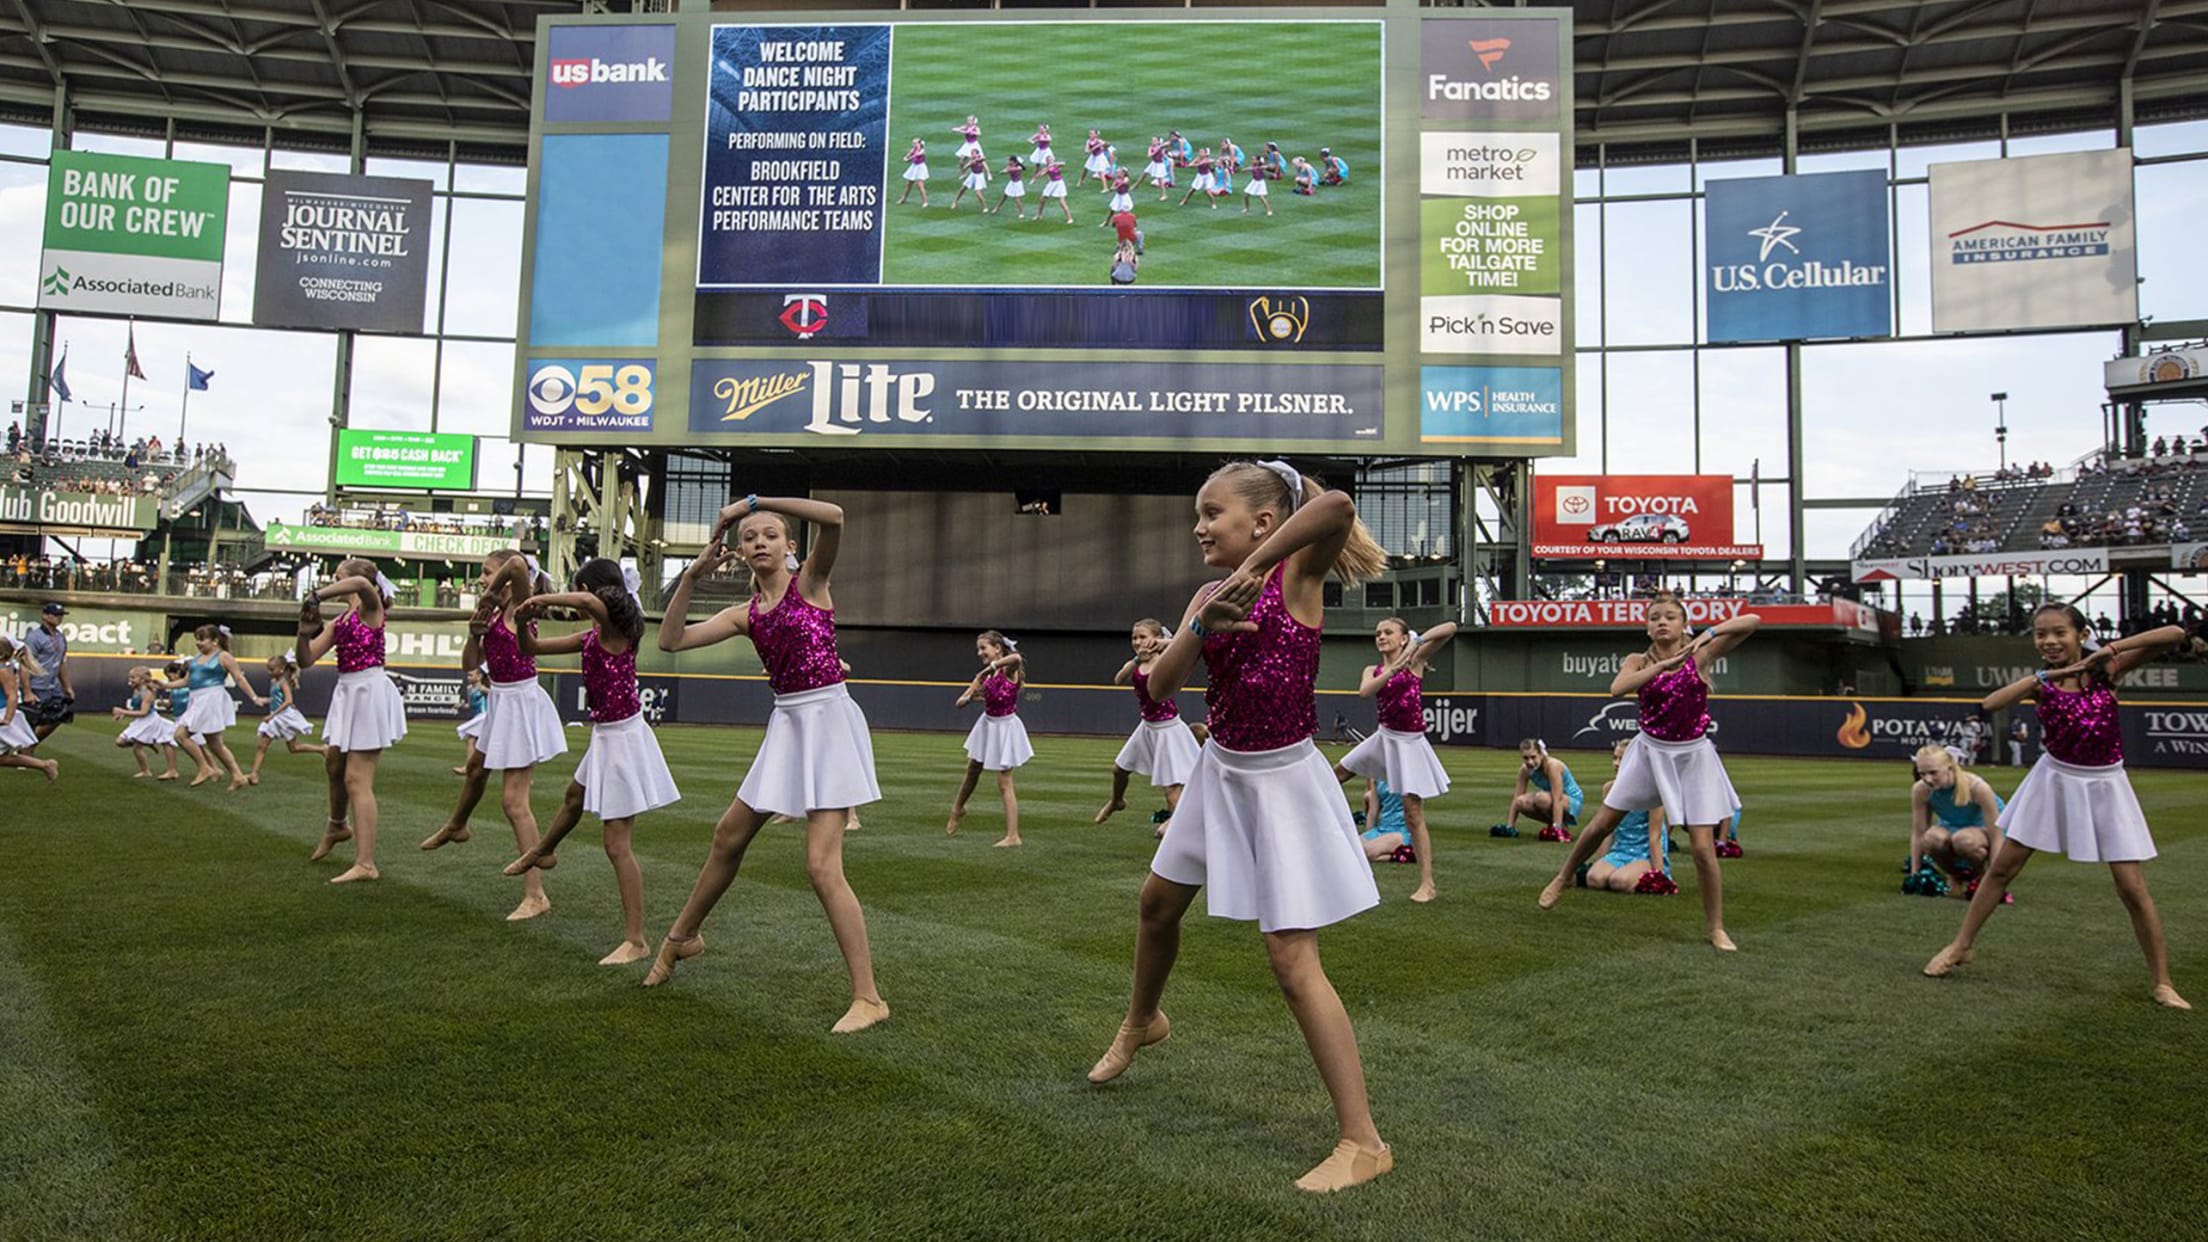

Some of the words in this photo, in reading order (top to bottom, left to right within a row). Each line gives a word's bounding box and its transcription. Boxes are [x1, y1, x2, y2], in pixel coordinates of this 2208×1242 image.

[759, 41, 845, 62] WELCOME
[552, 57, 667, 84] usbank
[743, 66, 800, 88] DANCE
[803, 66, 857, 87] NIGHT
[1429, 74, 1551, 101] Fanatics
[738, 90, 860, 112] PARTICIPANTS
[728, 132, 806, 150] PERFORMING
[808, 132, 826, 149] ON
[829, 131, 866, 149] FIELD:
[1447, 145, 1513, 162] metro
[751, 160, 840, 181] BROOKFIELD
[1447, 164, 1524, 180] market
[63, 169, 136, 201] BANK
[144, 175, 179, 204] OF
[712, 186, 769, 207] CENTER
[772, 186, 800, 206] FOR
[808, 186, 836, 206] THE
[839, 185, 877, 206] ARTS
[60, 201, 116, 231] OUR
[281, 204, 410, 234] JOURNAL
[713, 210, 820, 231] PERFORMANCE
[823, 210, 873, 231] TEAMS
[1464, 204, 1519, 220] SHOP
[1455, 221, 1528, 237] ONLINE
[280, 227, 408, 257] SENTINEL
[1440, 237, 1479, 253] FOR
[1485, 238, 1544, 254] MORE
[1953, 235, 2039, 250] AMERICAN
[2046, 230, 2109, 245] FAMILY
[296, 251, 391, 268] jsonline.com
[1446, 254, 1537, 271] TAILGATE
[1964, 246, 2097, 262] INSURANCE
[299, 277, 382, 292] CONNECTING
[1465, 271, 1518, 287] TIME!
[1712, 264, 1761, 292] U.S.
[1763, 260, 1886, 289] Cellular
[305, 288, 376, 302] WISCONSIN
[1499, 317, 1554, 335] Save
[575, 364, 652, 415] 58
[713, 371, 811, 419] Miller
[803, 360, 935, 435] Lite
[1492, 392, 1535, 402] HEALTH
[955, 389, 1010, 410] THE
[1017, 390, 1143, 412] ORIGINAL
[1150, 392, 1230, 413] LIGHT
[1237, 393, 1354, 415] PILSNER.
[1426, 390, 1480, 413] WPS
[1492, 402, 1557, 414] INSURANCE
[530, 416, 566, 426] WDJT
[576, 416, 649, 426] MILWAUKEE
[40, 491, 136, 527] Goodwill
[1604, 496, 1698, 514] TOYOTA
[1622, 527, 1659, 539] RAV4
[414, 536, 465, 552] CHECK
[1534, 545, 1581, 555] COURTESY
[1583, 545, 1596, 555] OF
[1598, 545, 1622, 555] YOUR
[1624, 546, 1678, 555] WISCONSIN
[1680, 546, 1716, 555] TOYOTA
[1718, 546, 1760, 556] DEALERS
[1496, 603, 1590, 623] TOYOTA
[1598, 601, 1744, 623] TERORY
[421, 684, 461, 695] FAMILY
